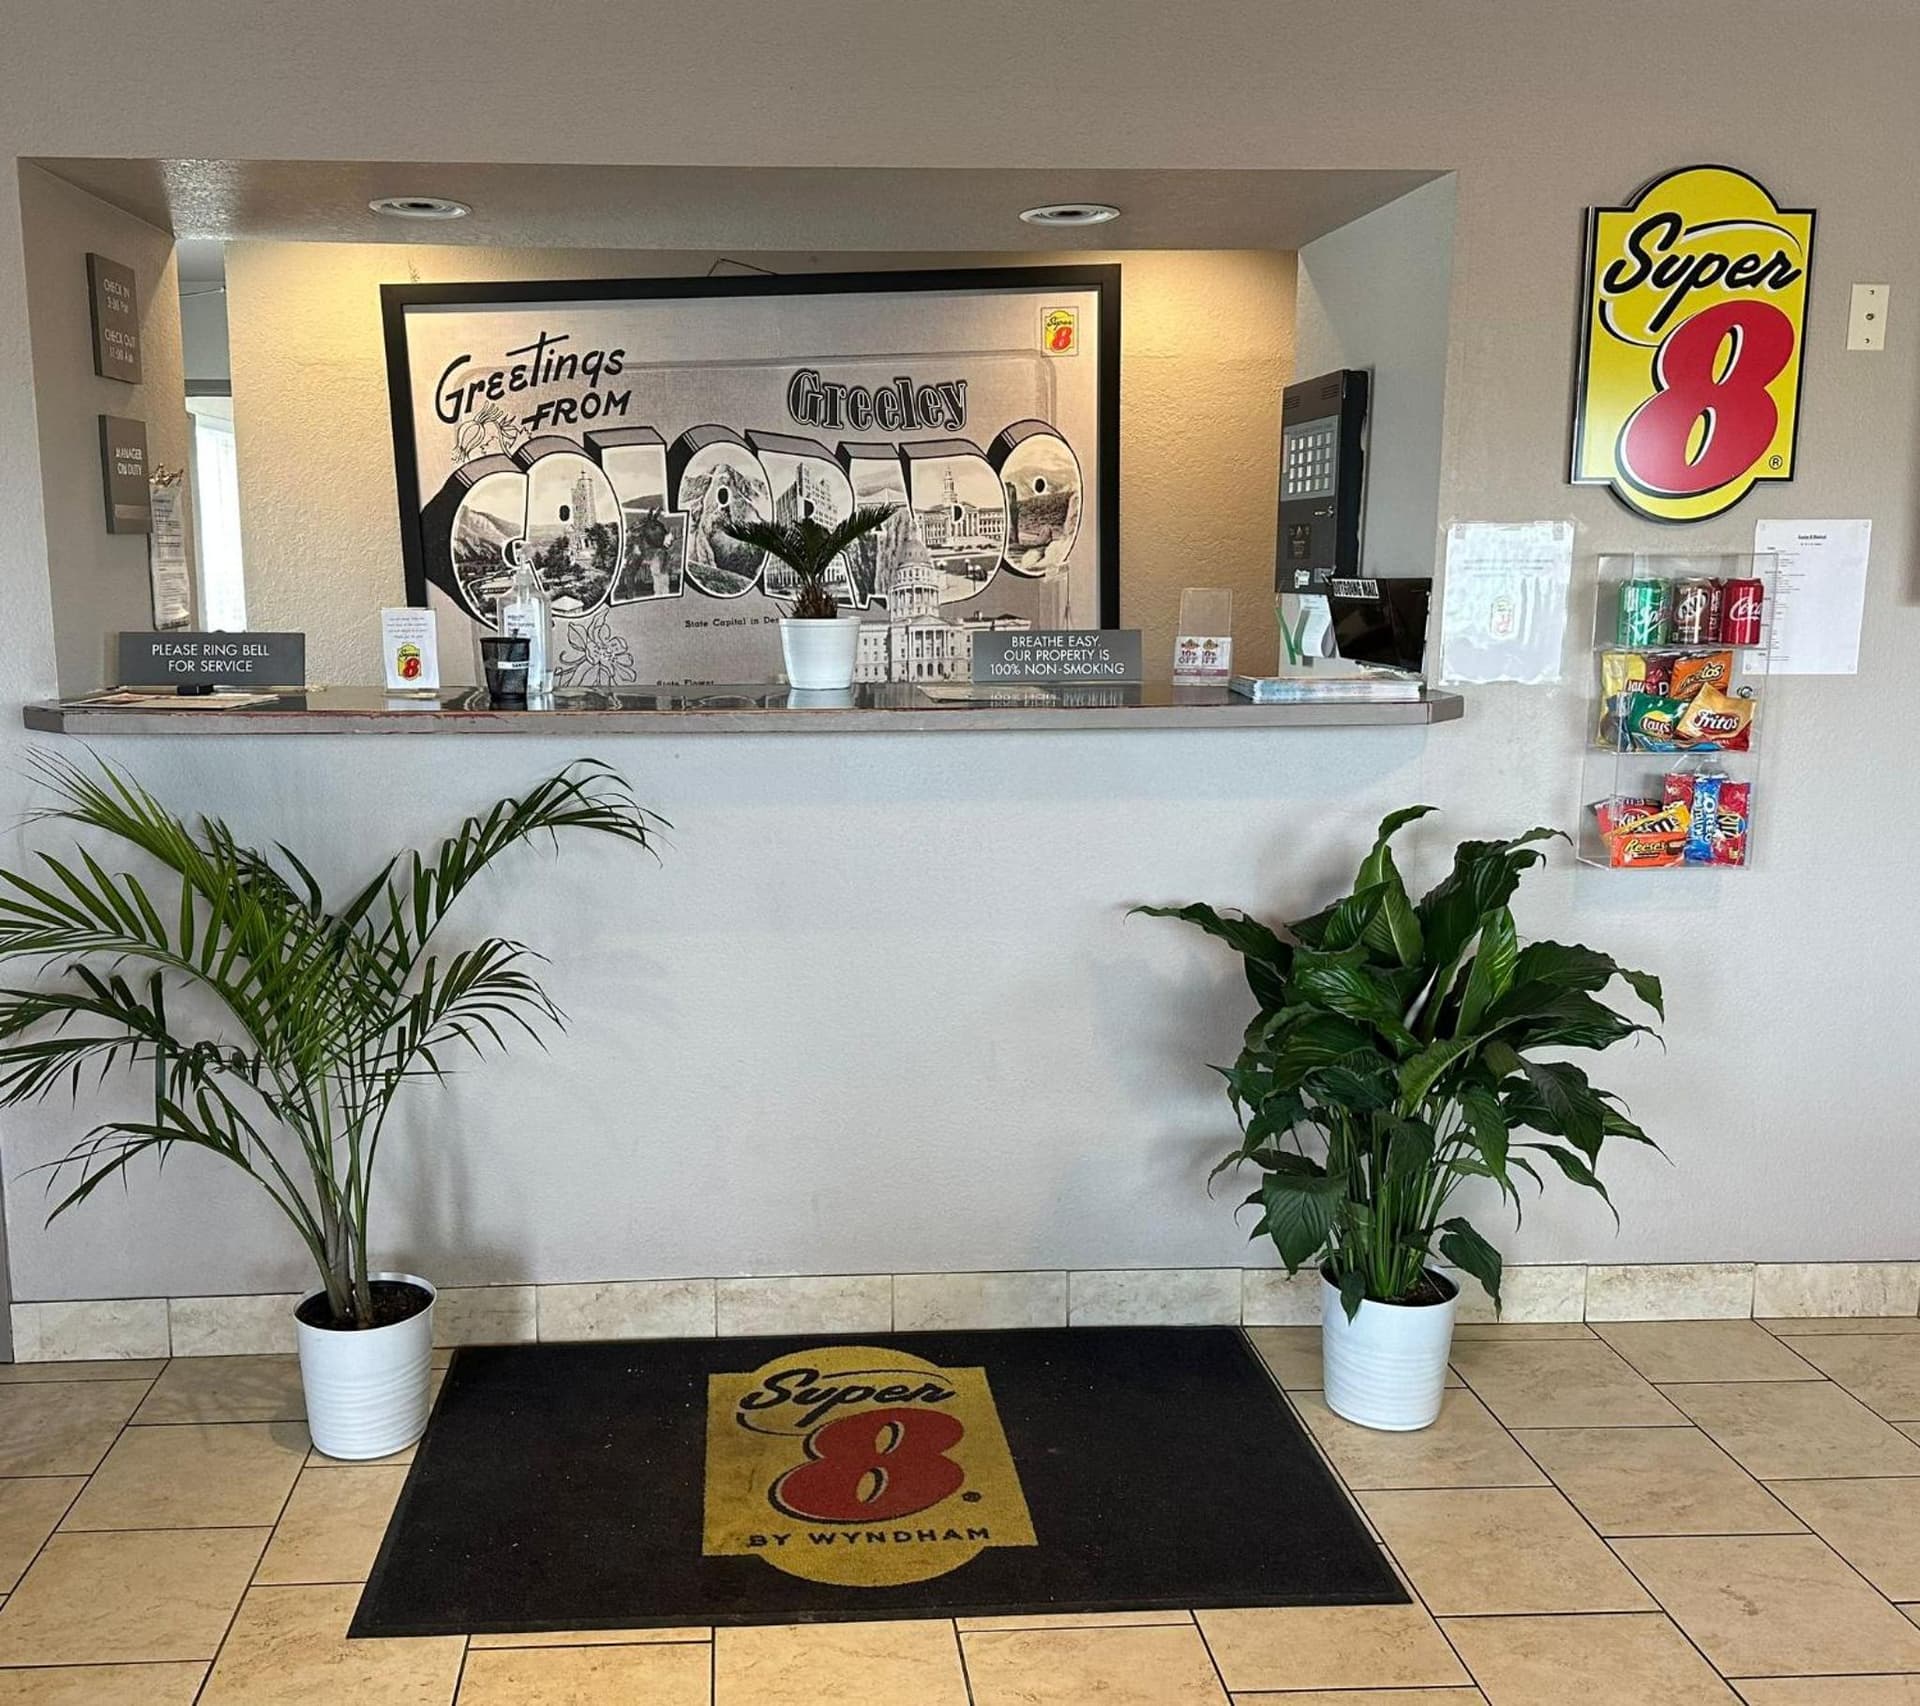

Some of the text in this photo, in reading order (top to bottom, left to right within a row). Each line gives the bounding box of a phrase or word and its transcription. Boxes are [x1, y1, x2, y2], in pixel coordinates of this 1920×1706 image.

[1602, 212, 1802, 333] Super
[1051, 326, 1073, 351] 8
[435, 331, 626, 425] Greetings
[521, 389, 633, 431] FROM
[787, 368, 969, 432] Greeley
[1615, 299, 1796, 500] 8
[115, 447, 143, 460] MANAGER
[684, 619, 709, 629] State
[712, 617, 747, 628] Capital
[750, 616, 759, 625] in
[152, 643, 270, 656] PLEASE RING BELL
[1011, 636, 1064, 648] BREATHE
[168, 660, 253, 672] FOR SERVICE
[1004, 649, 1110, 661] OUR PROPERTY IS
[403, 656, 421, 678] 8
[990, 663, 1125, 676] 100% NON-SMOKING
[1696, 710, 1739, 732] Fritos
[1703, 798, 1716, 842] OREO
[739, 1368, 957, 1428] Super
[768, 1407, 965, 1525] 8
[748, 1526, 991, 1548] BY WYNDHAM
